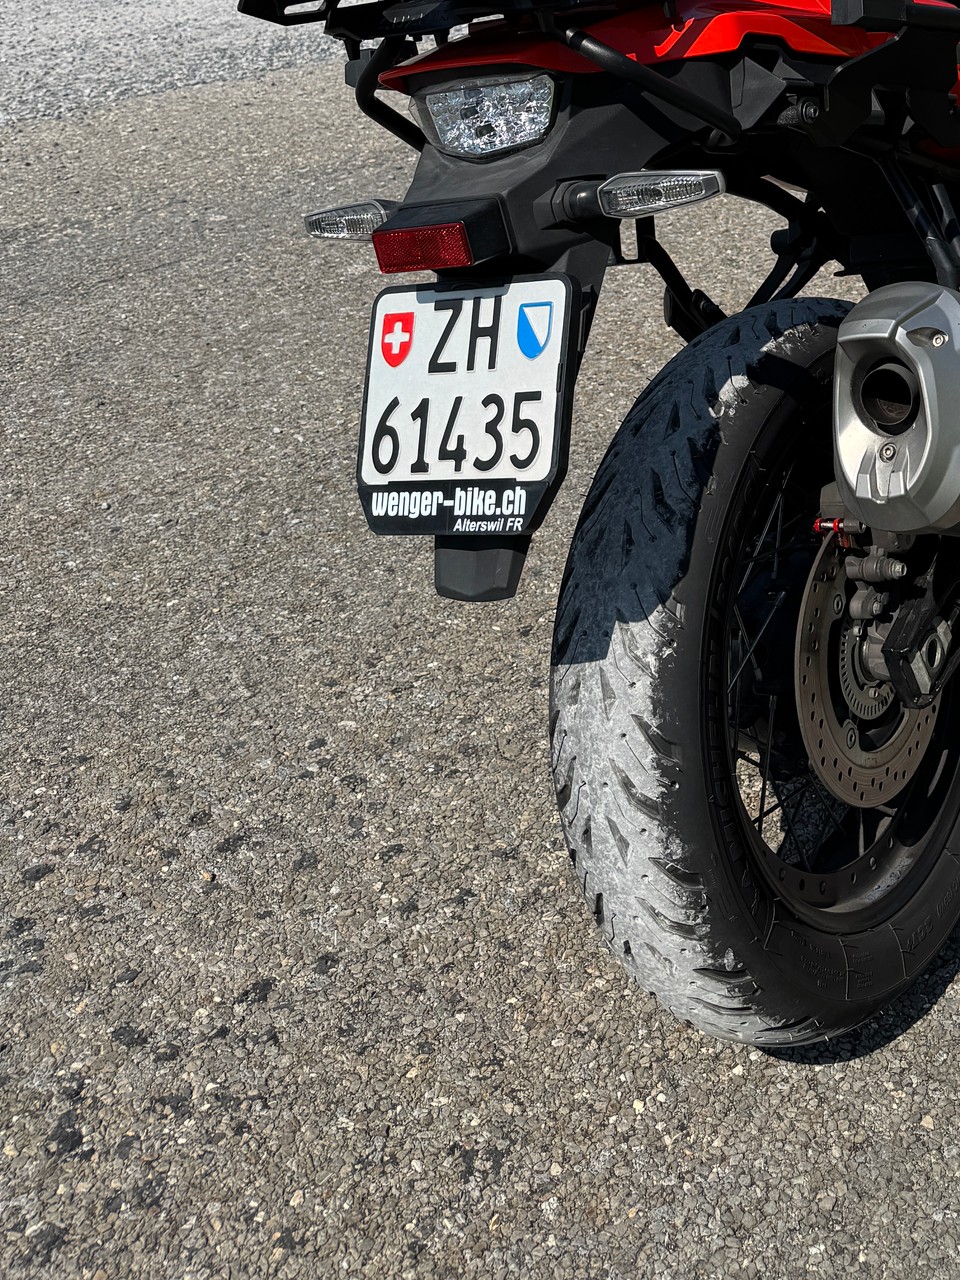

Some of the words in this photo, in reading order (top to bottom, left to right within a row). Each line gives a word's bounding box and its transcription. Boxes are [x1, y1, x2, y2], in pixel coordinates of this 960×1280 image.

[428, 295, 503, 374] ZH
[371, 390, 542, 475] 61435
[371, 486, 527, 519] wenger-bike.ch
[453, 518, 504, 533] Alterswil
[506, 518, 523, 531] FR
